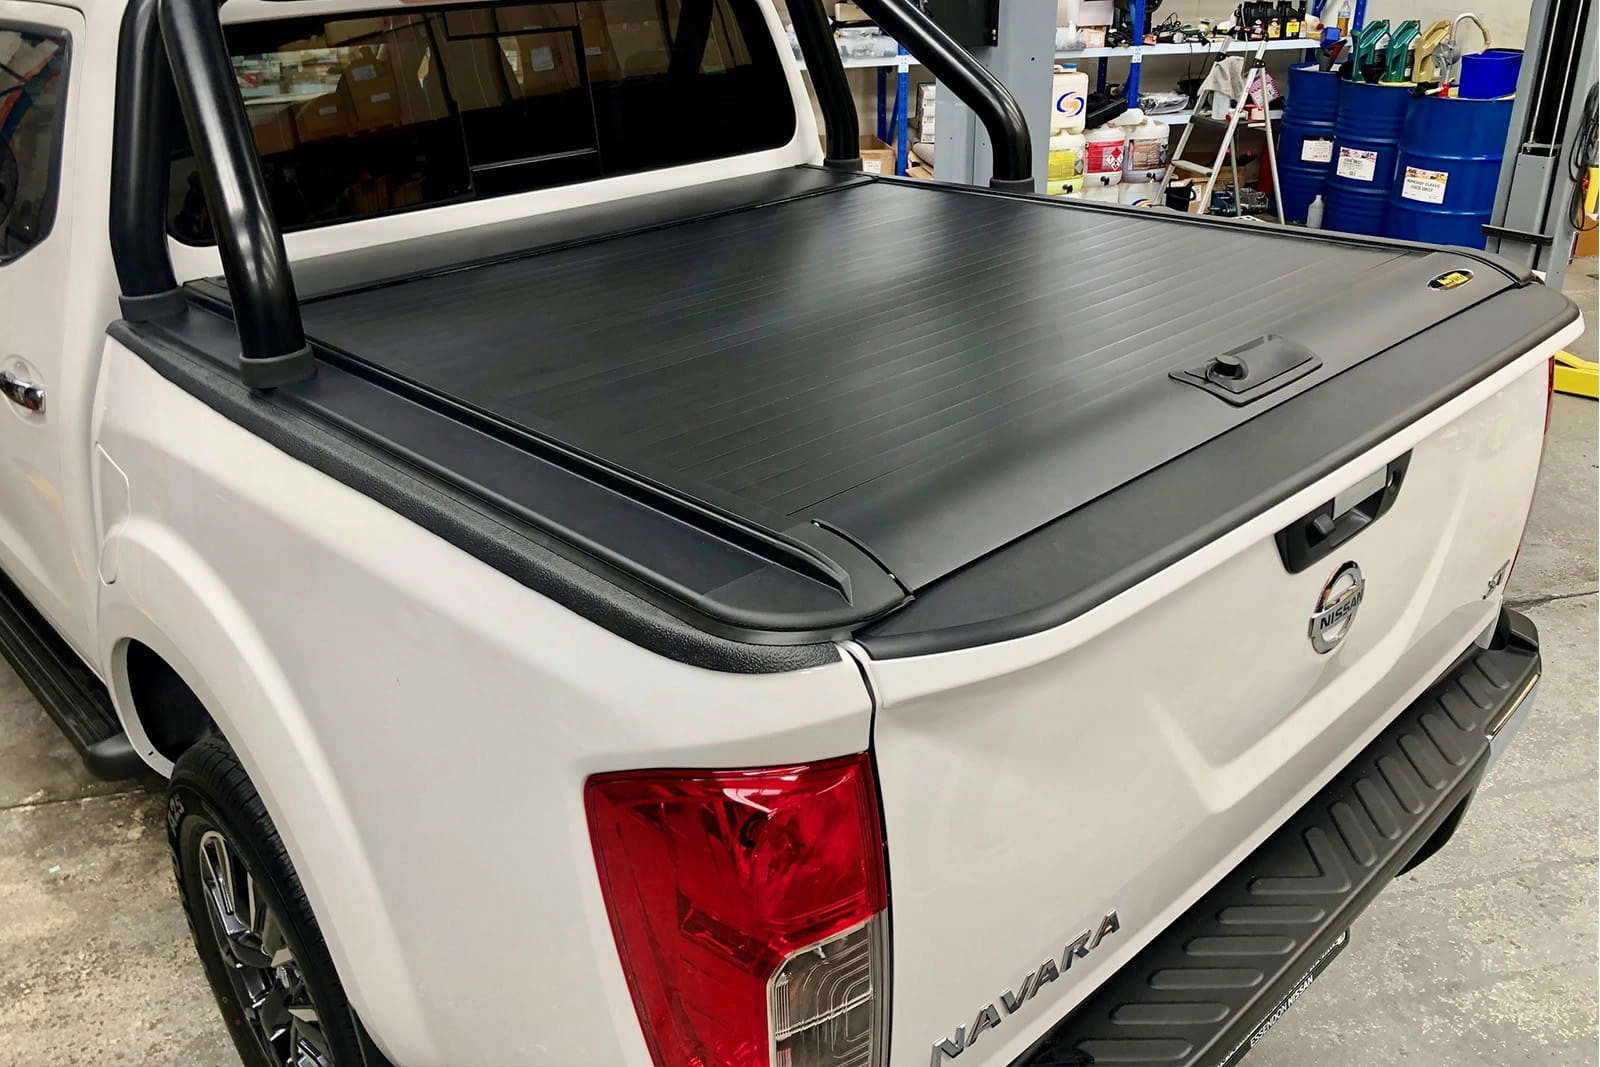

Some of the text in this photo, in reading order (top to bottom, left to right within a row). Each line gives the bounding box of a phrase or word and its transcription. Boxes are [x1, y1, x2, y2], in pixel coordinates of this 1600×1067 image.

[1320, 591, 1364, 630] NISSAN
[930, 909, 1121, 1067] NAVARA
[1250, 975, 1314, 1047] ESSENDON NISSAN
